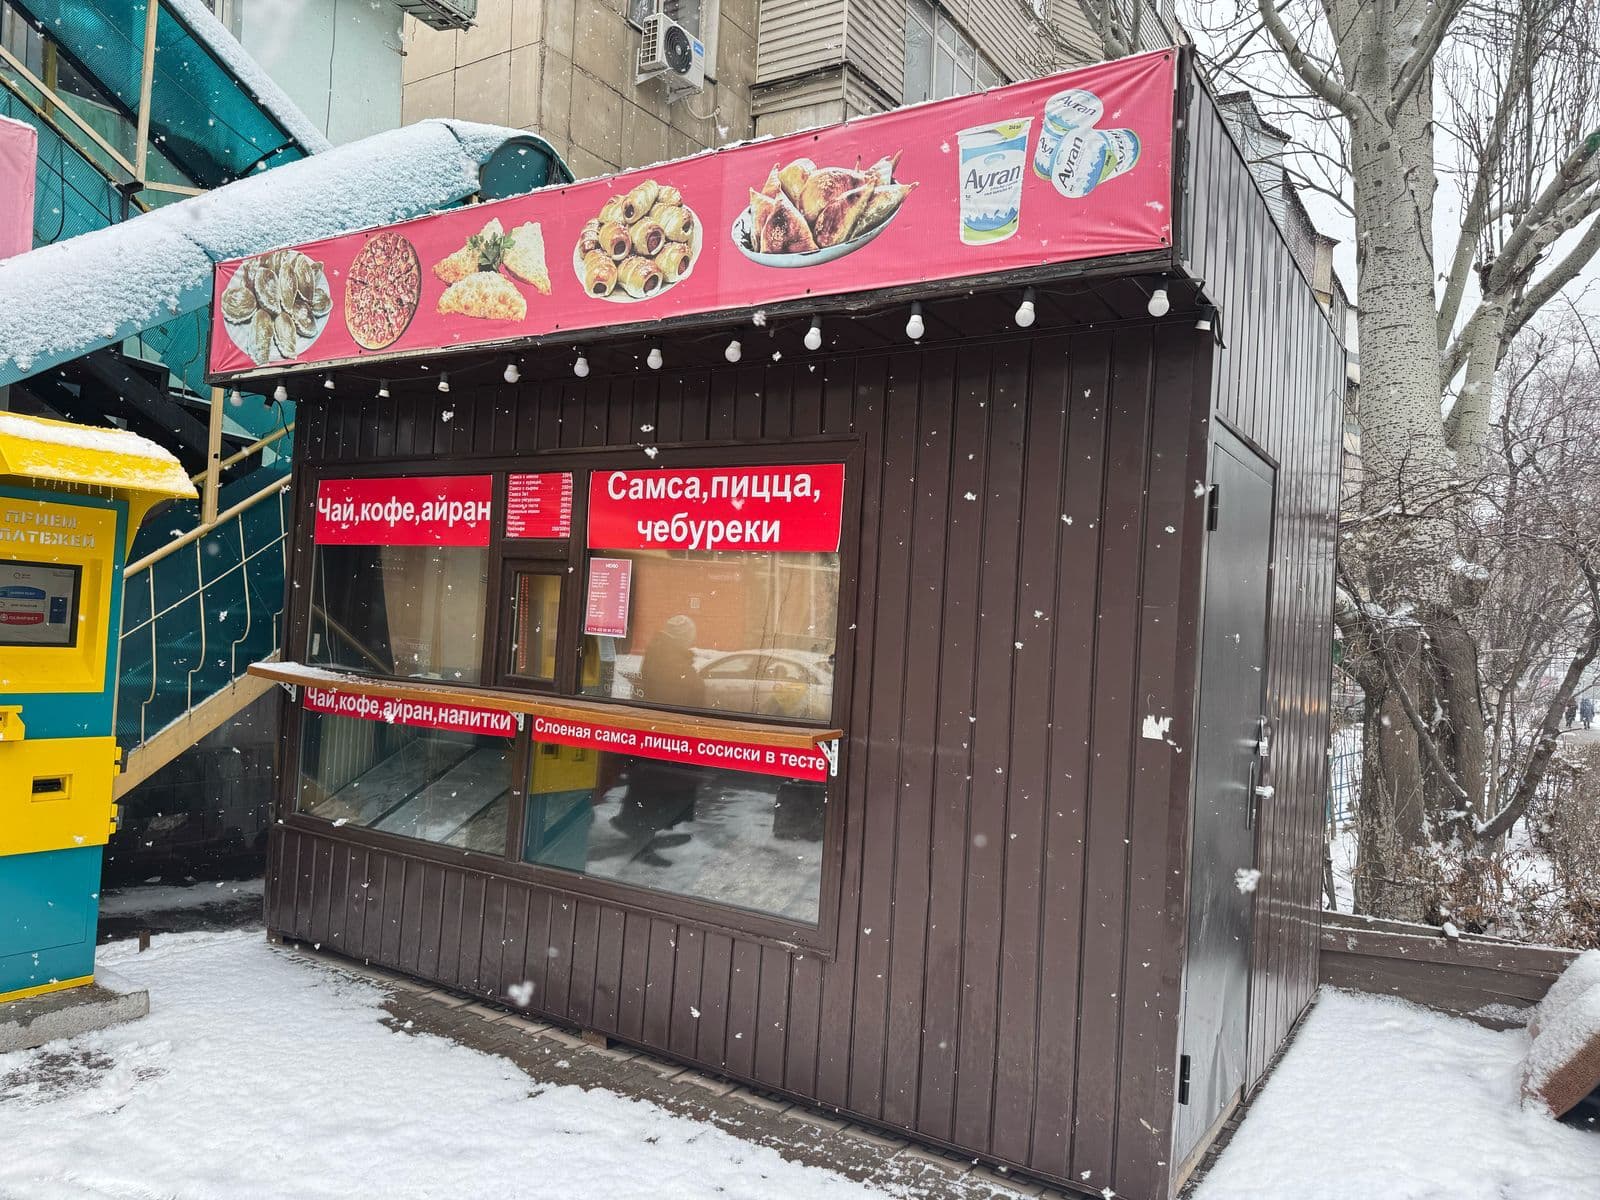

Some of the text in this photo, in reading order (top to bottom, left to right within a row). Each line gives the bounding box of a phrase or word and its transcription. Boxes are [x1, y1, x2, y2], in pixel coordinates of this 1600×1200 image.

[1058, 95, 1096, 115] Ayran
[1058, 136, 1083, 189] Ayran
[964, 166, 1020, 193] Ayran
[607, 471, 821, 504] Самса,пицца,
[5, 510, 77, 529] ПРИЕМ
[318, 495, 492, 528] Чай,кофе,айран
[0, 528, 95, 548] ЛАТЕЖЕЙ
[637, 512, 781, 550] чебуреки
[306, 688, 512, 731] Чай,кофе,айран,напитки
[534, 717, 591, 740] Слоеная
[595, 726, 637, 746] самса
[697, 741, 761, 762] сосиски
[765, 752, 776, 764] в
[779, 752, 826, 771] тесте
